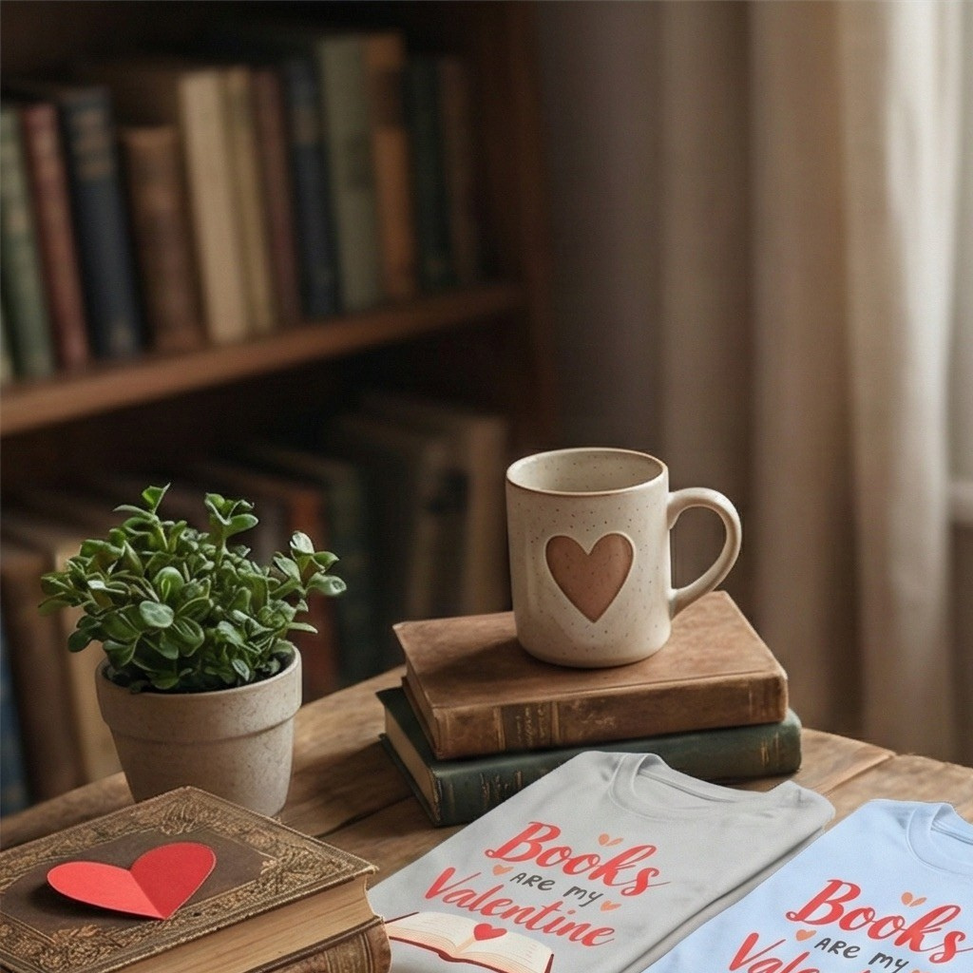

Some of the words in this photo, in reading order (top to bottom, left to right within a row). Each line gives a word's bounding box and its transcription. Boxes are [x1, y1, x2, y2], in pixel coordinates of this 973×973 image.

[484, 821, 671, 896] Books
[425, 867, 615, 946] Valentine
[563, 885, 603, 908] my
